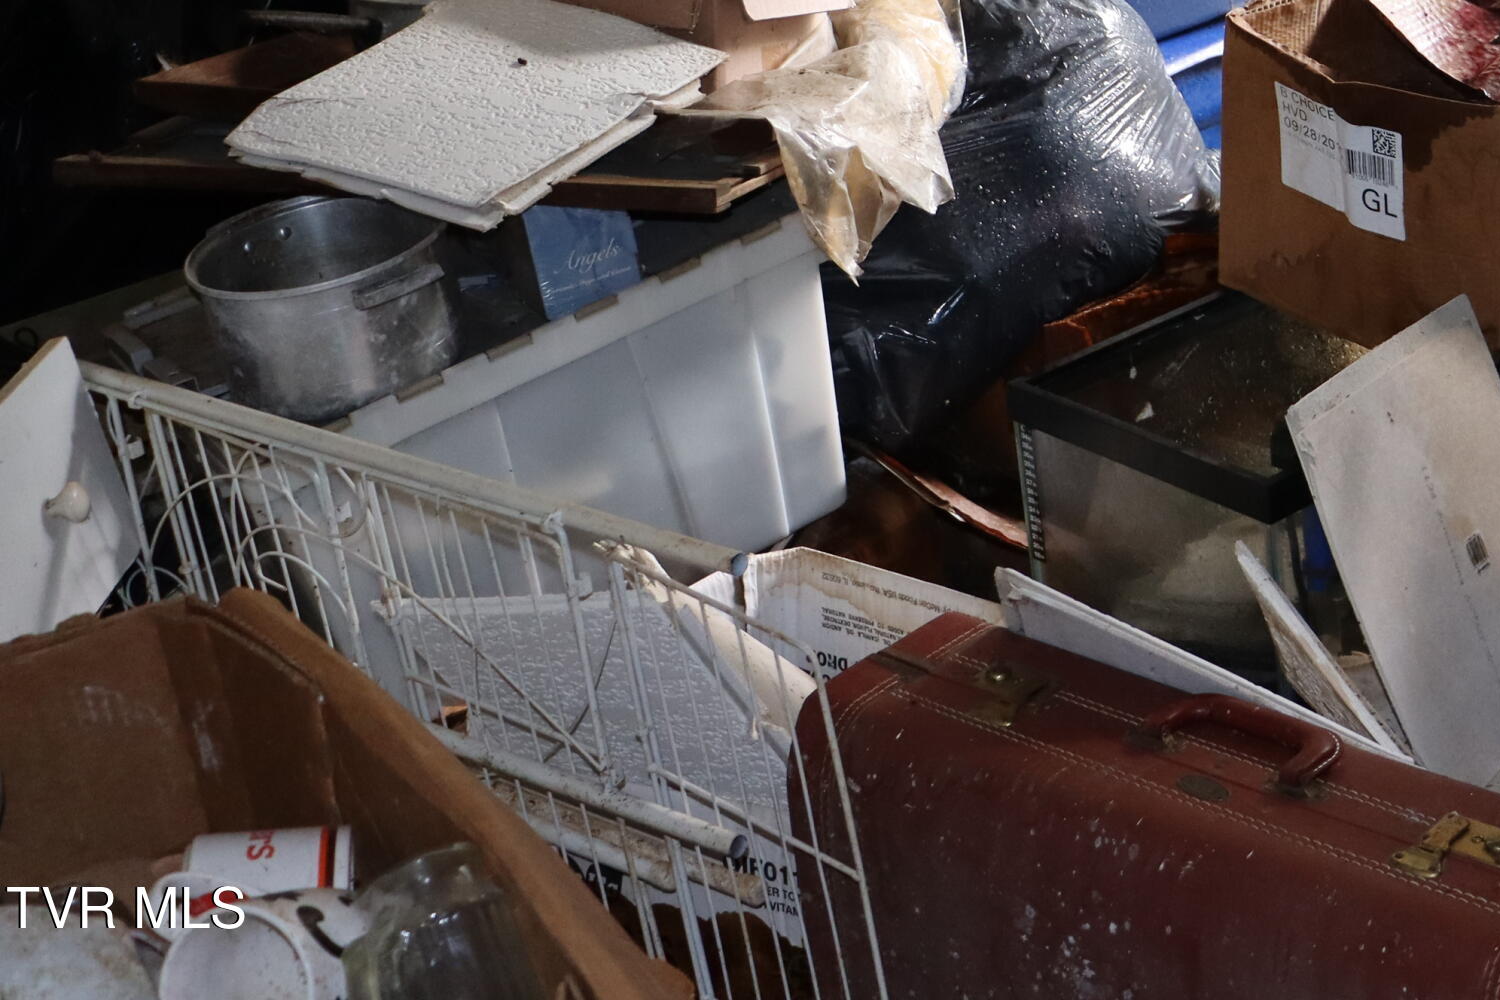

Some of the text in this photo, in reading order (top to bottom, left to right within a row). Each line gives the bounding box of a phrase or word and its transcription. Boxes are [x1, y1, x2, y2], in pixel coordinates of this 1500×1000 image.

[1282, 101, 1308, 122] HVD
[1291, 91, 1336, 121] CHOICE
[1283, 116, 1341, 152] 09/28/20
[1361, 187, 1398, 219] GL
[552, 237, 621, 274] Angels
